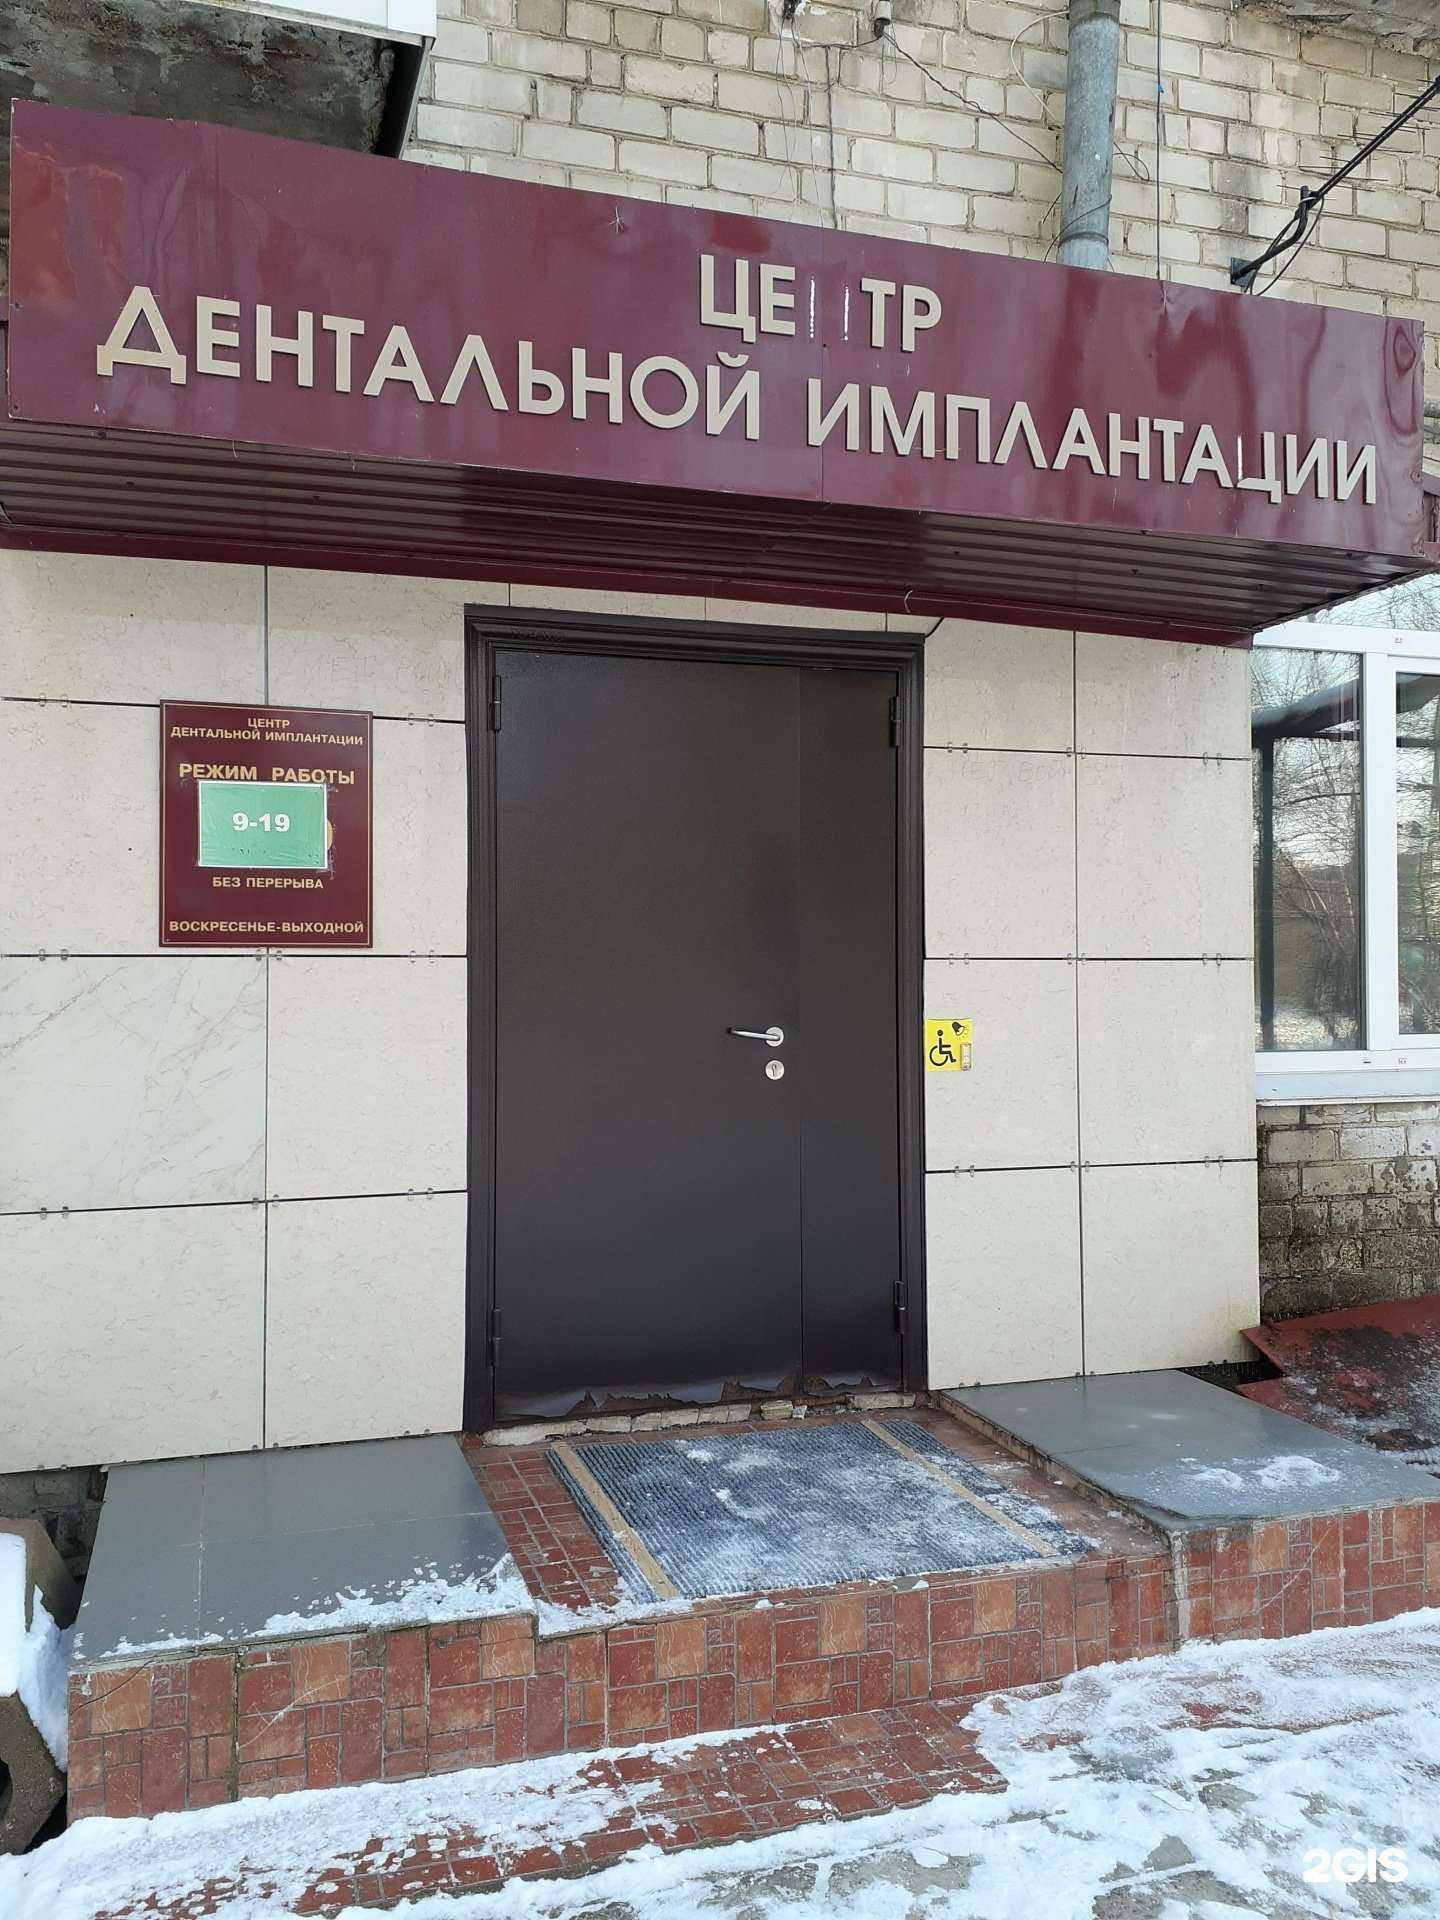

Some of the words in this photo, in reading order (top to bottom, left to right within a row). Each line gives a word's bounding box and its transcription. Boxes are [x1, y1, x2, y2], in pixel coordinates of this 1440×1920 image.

[699, 253, 943, 353] ЦЕТР
[95, 284, 761, 442] ДЕНТАЛЬНОЙ
[806, 377, 1377, 505] ИМПЛАНТАЦИИ
[247, 717, 291, 729] ЦЕНТР
[170, 726, 261, 741] ДЕНТАЛЬНОЙ
[265, 731, 364, 746] ИМПЛАНТАЦИИ
[178, 763, 258, 780] РЕЖИМ
[271, 767, 356, 785] РАБОТЫ
[232, 812, 291, 832] 9-19
[212, 876, 242, 889] БЕЗ
[245, 877, 324, 890] ПЕРЕРЫВА
[168, 920, 365, 935] ВОСКРЕСЕНЬЕ-ВЫХОДНОЙ
